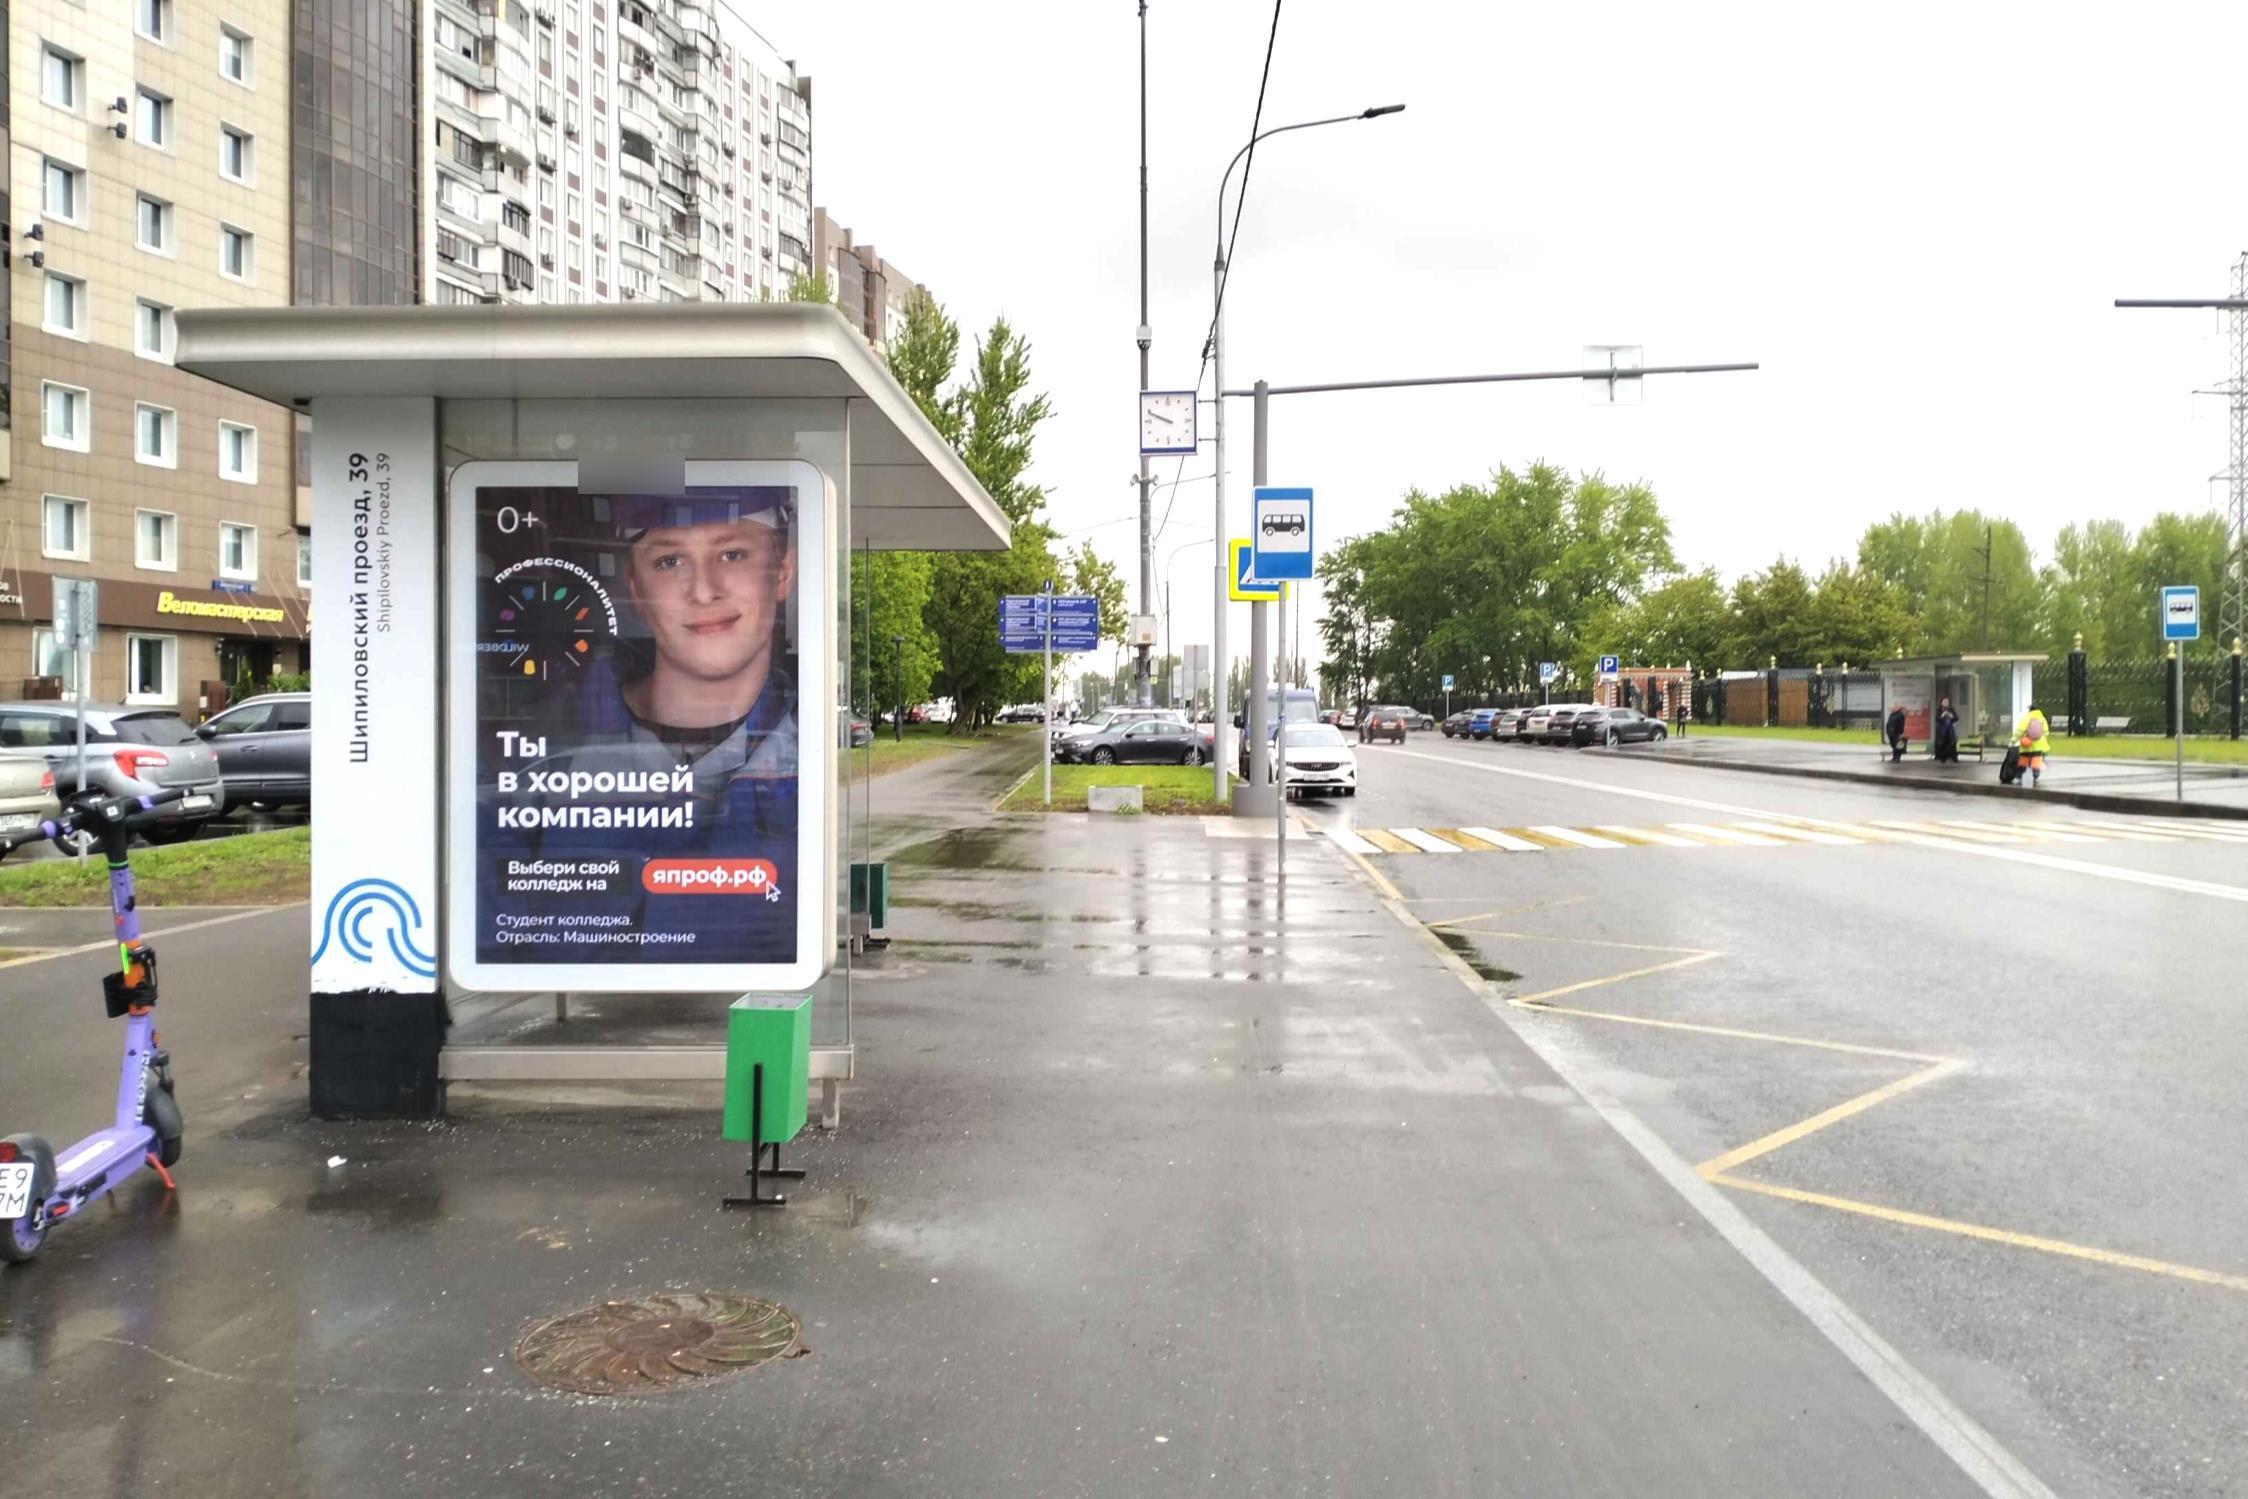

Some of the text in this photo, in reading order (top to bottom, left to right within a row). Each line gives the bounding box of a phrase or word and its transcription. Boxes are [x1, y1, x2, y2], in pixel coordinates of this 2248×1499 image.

[497, 506, 539, 534] 0+
[376, 452, 392, 633] Shipilovskiy Proezd, 39
[157, 592, 284, 623] Веломастерская
[349, 453, 373, 763] Шипиловский проезд, 39
[494, 557, 618, 637] ПРОФЕССИОНАЛИТЕТ
[496, 731, 547, 757] Ты
[498, 764, 694, 799] в хорошей
[498, 801, 694, 828] компании!
[508, 860, 620, 877] Выбери свой
[652, 865, 768, 888] япроф.рф
[507, 879, 607, 893] колледж на
[496, 914, 634, 929] Студент колледжа.
[496, 931, 696, 945] Отрасль: Машиностроение
